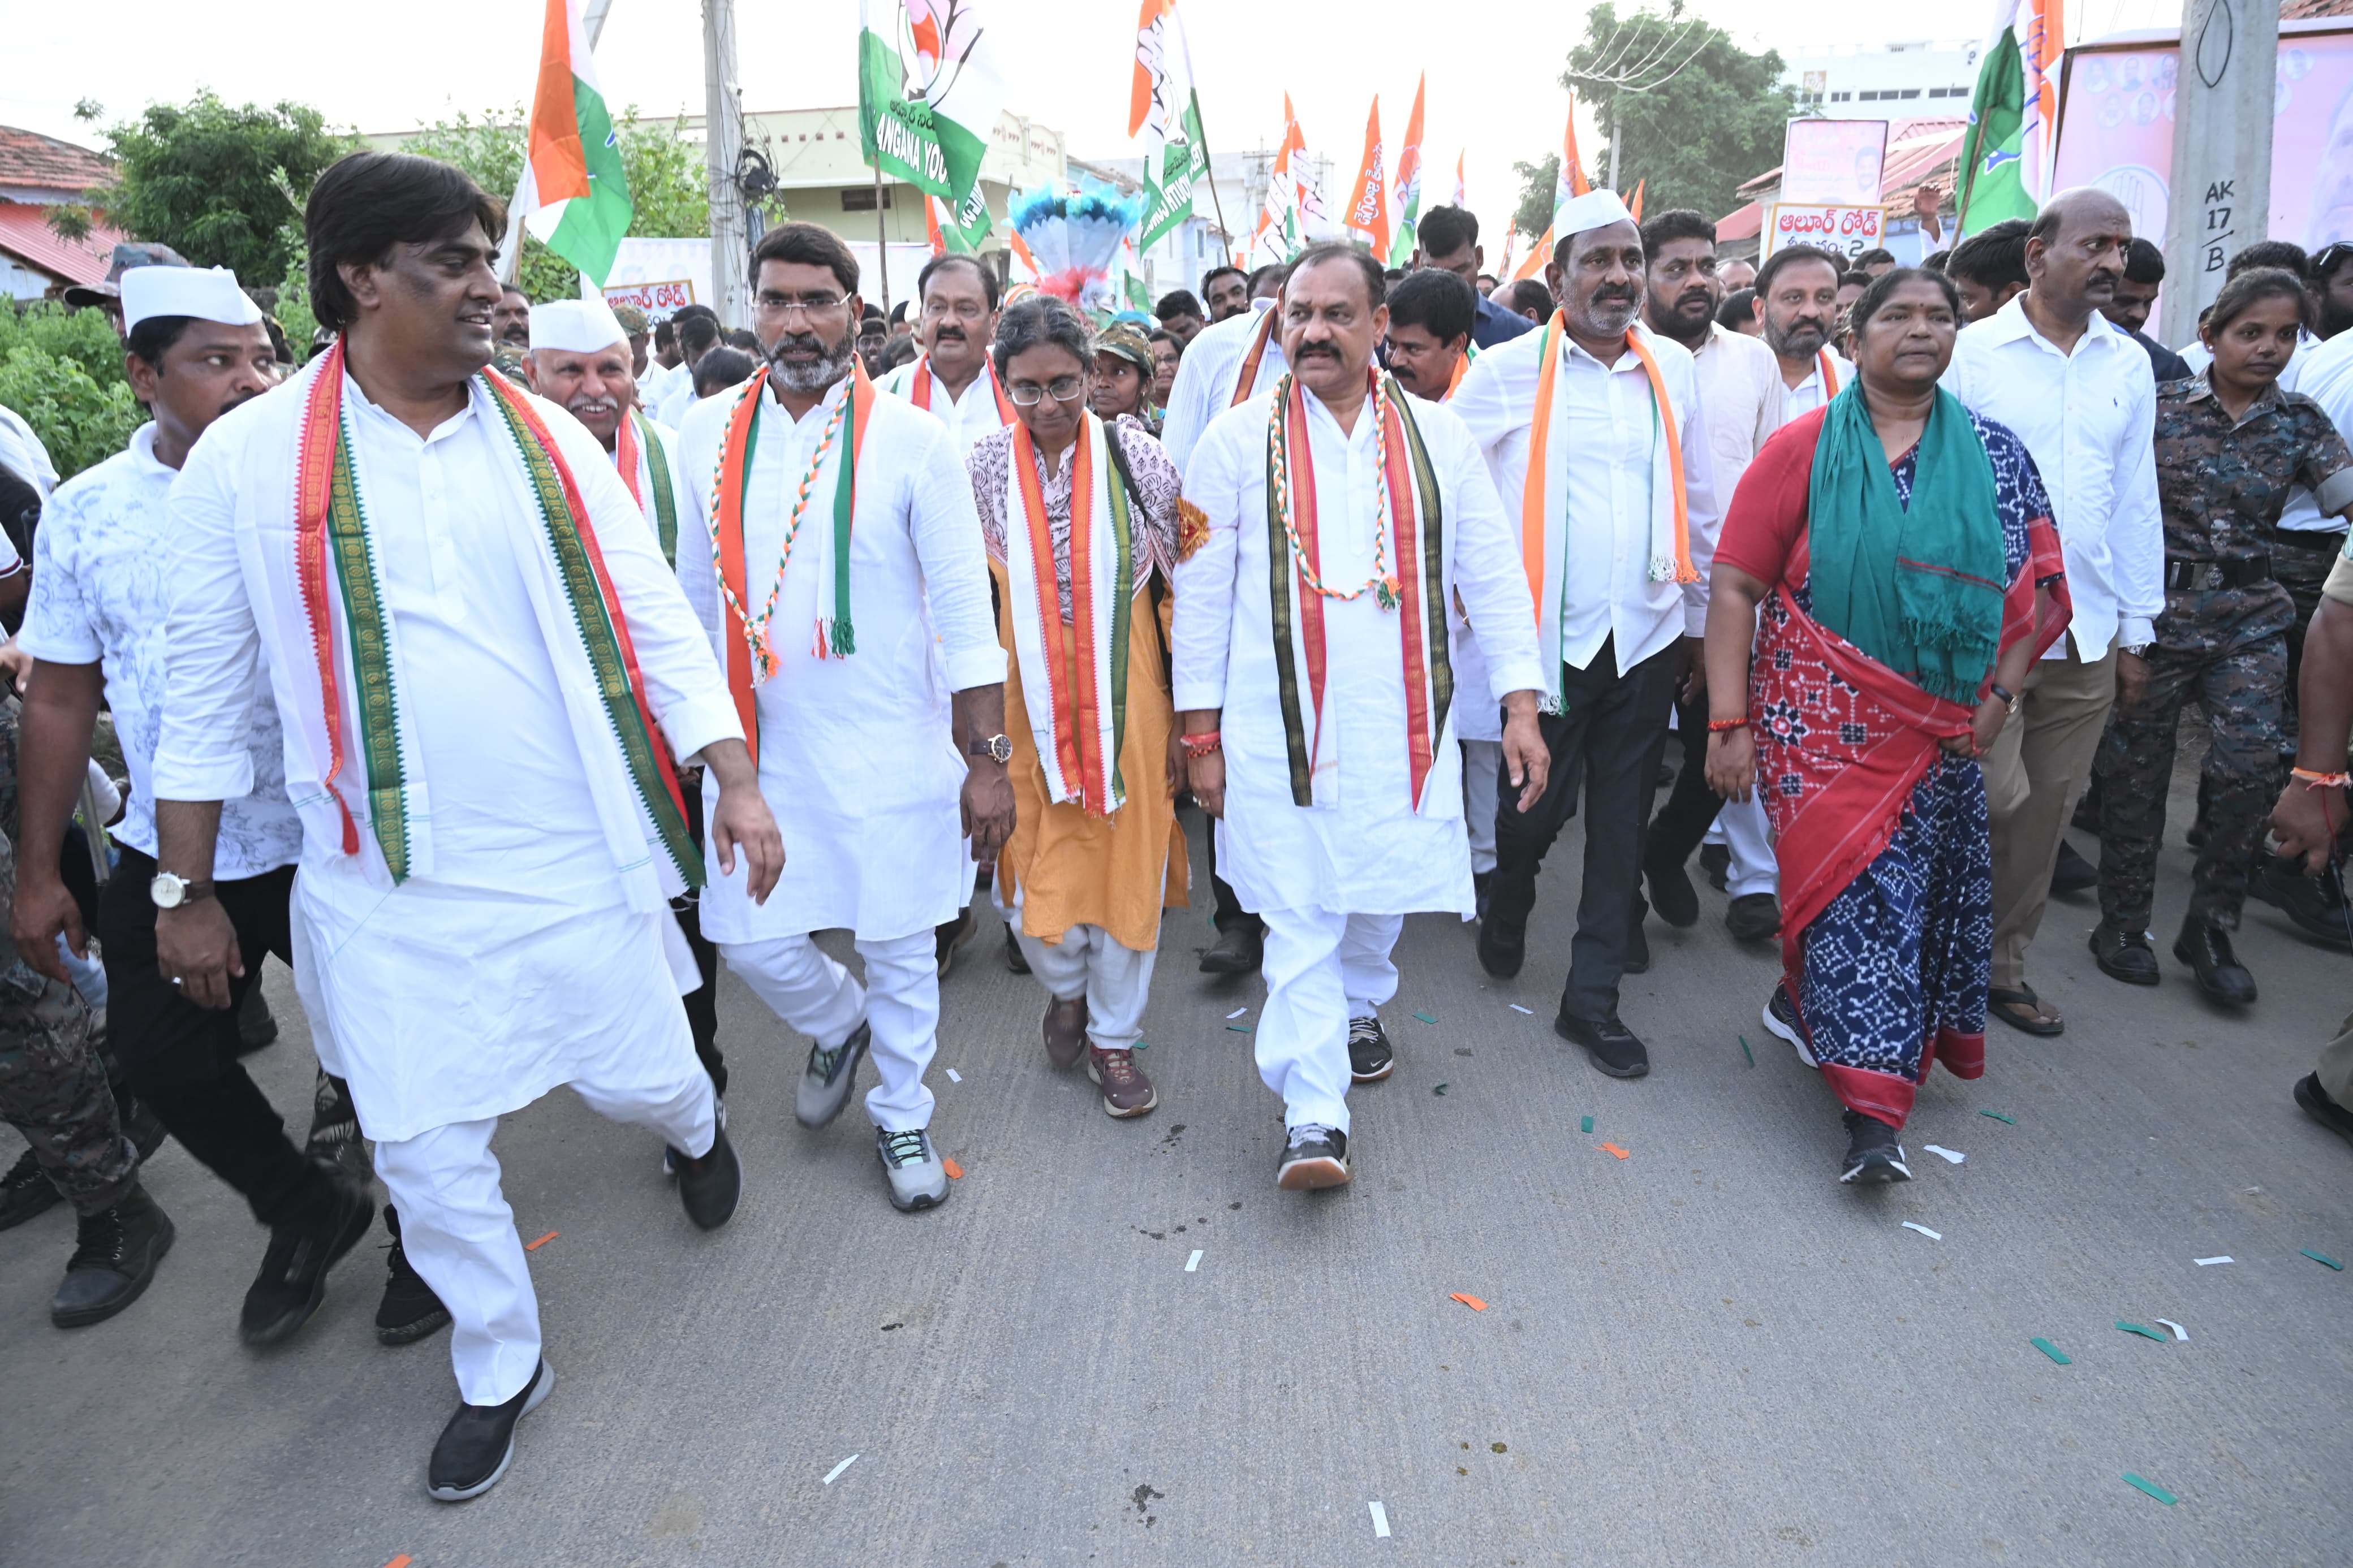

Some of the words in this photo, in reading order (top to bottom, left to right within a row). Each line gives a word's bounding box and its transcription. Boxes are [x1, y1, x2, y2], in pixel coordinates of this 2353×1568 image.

[876, 112, 921, 173] ANGANA
[923, 139, 949, 185] YOU
[2205, 180, 2234, 205] AK
[1779, 209, 1837, 234] ఆలూర్
[1841, 209, 1878, 236] రోడ్
[2207, 207, 2231, 230] 17
[1848, 240, 1865, 257] 2
[2205, 247, 2225, 272] B
[657, 284, 686, 308] రోడ్
